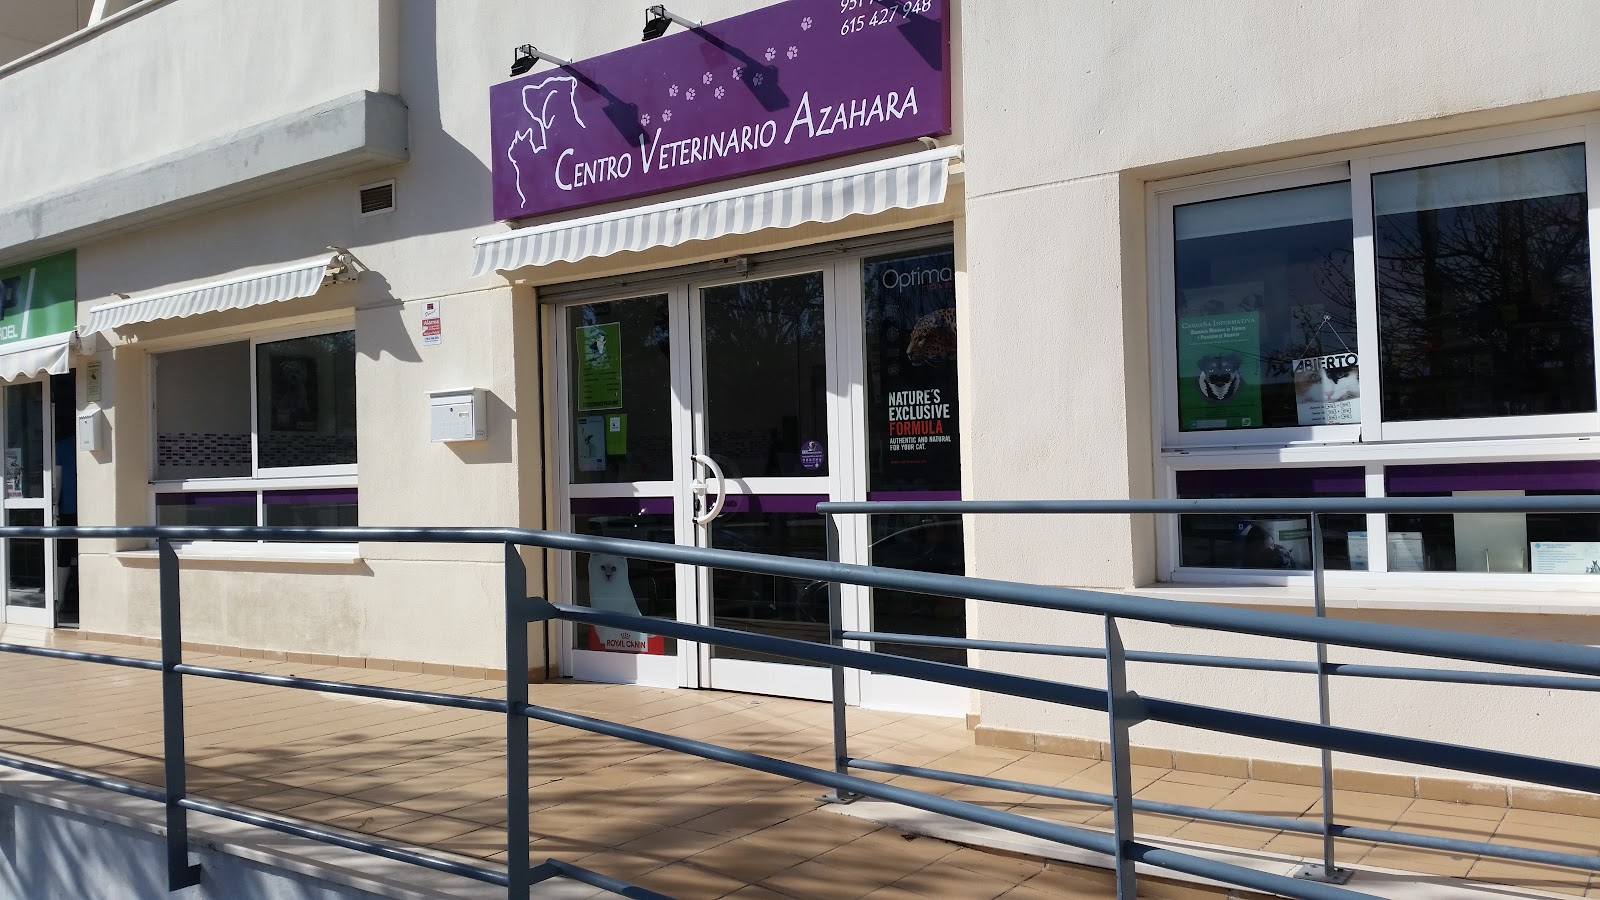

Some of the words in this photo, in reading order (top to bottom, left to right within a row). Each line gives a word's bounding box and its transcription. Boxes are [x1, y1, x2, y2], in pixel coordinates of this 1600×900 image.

[840, 15, 866, 36] 615
[868, 5, 899, 26] 427
[902, 0, 932, 19] 948
[555, 148, 632, 191] CENTRO
[638, 120, 777, 174] VETERINARIO
[784, 86, 918, 145] AZAHARA
[882, 267, 953, 293] Optima
[1294, 354, 1358, 372] ABIERTO
[888, 388, 941, 407] NATURE'S
[888, 403, 951, 421] EXCLUSIVE
[889, 419, 943, 436] FORMULA
[889, 436, 917, 445] AUTHENTIC
[917, 435, 929, 443] AND
[929, 434, 952, 443] NATURAL
[901, 443, 915, 451] YOUR
[606, 639, 625, 648] ROYAL
[626, 640, 646, 649] CANIN
